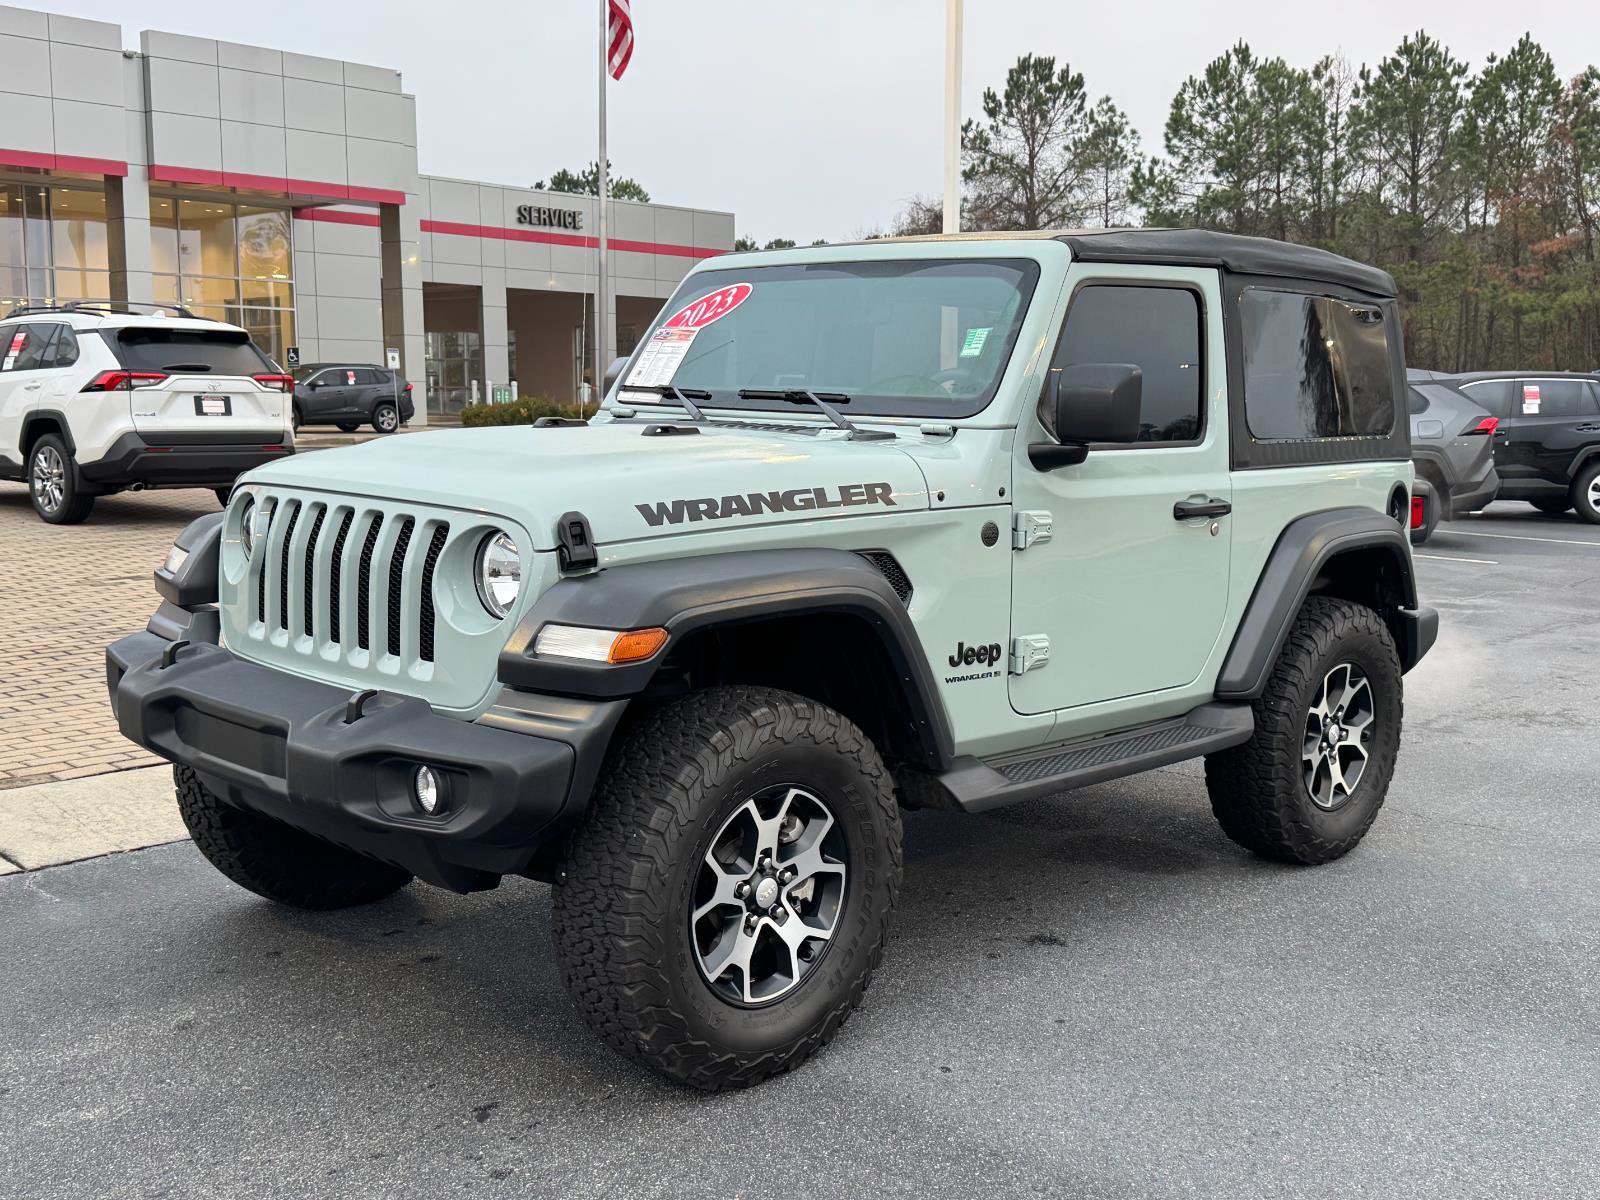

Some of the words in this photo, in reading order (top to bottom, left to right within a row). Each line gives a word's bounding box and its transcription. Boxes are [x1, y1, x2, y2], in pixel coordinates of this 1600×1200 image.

[517, 205, 583, 229] SERVICE
[678, 287, 738, 327] 2023
[635, 482, 897, 527] WRANGLER
[949, 641, 1001, 667] Jeep
[945, 672, 992, 684] WRANGLER
